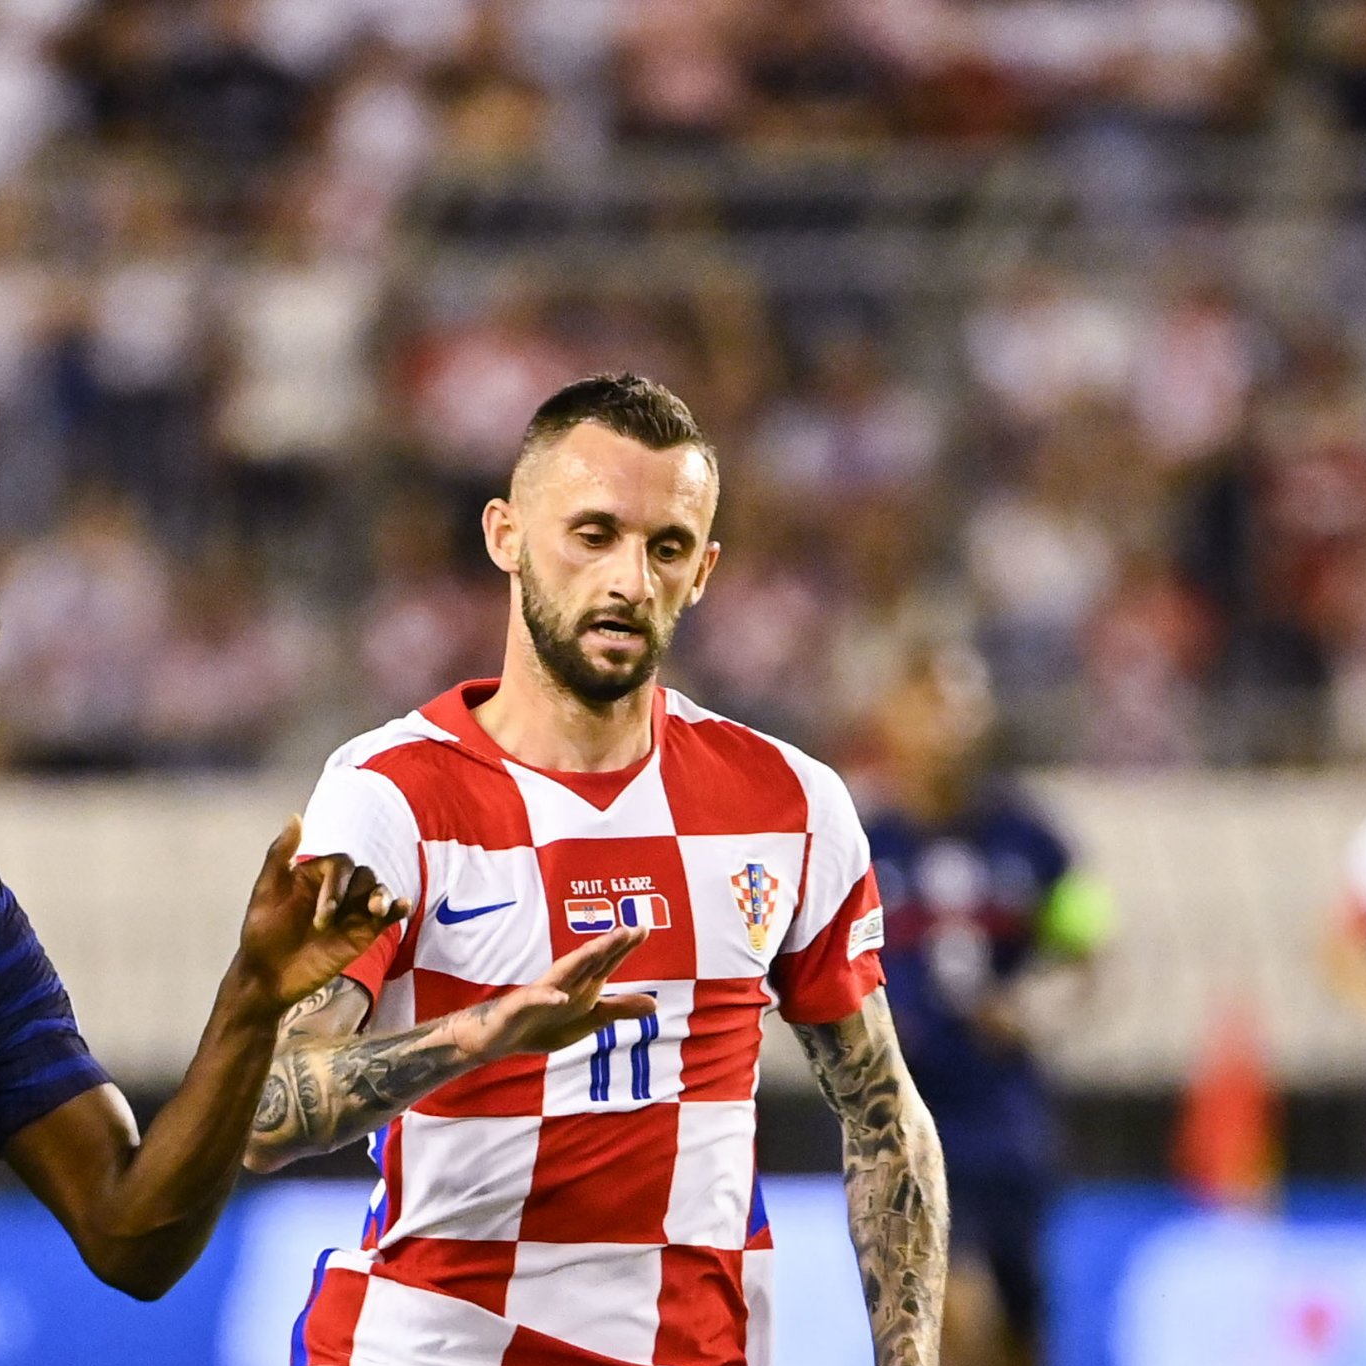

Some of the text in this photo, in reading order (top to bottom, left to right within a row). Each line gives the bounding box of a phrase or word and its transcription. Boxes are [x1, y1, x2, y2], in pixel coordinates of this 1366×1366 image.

[570, 879, 608, 895] SPLIT,
[750, 870, 762, 915] HNS
[589, 990, 659, 1101] 11
